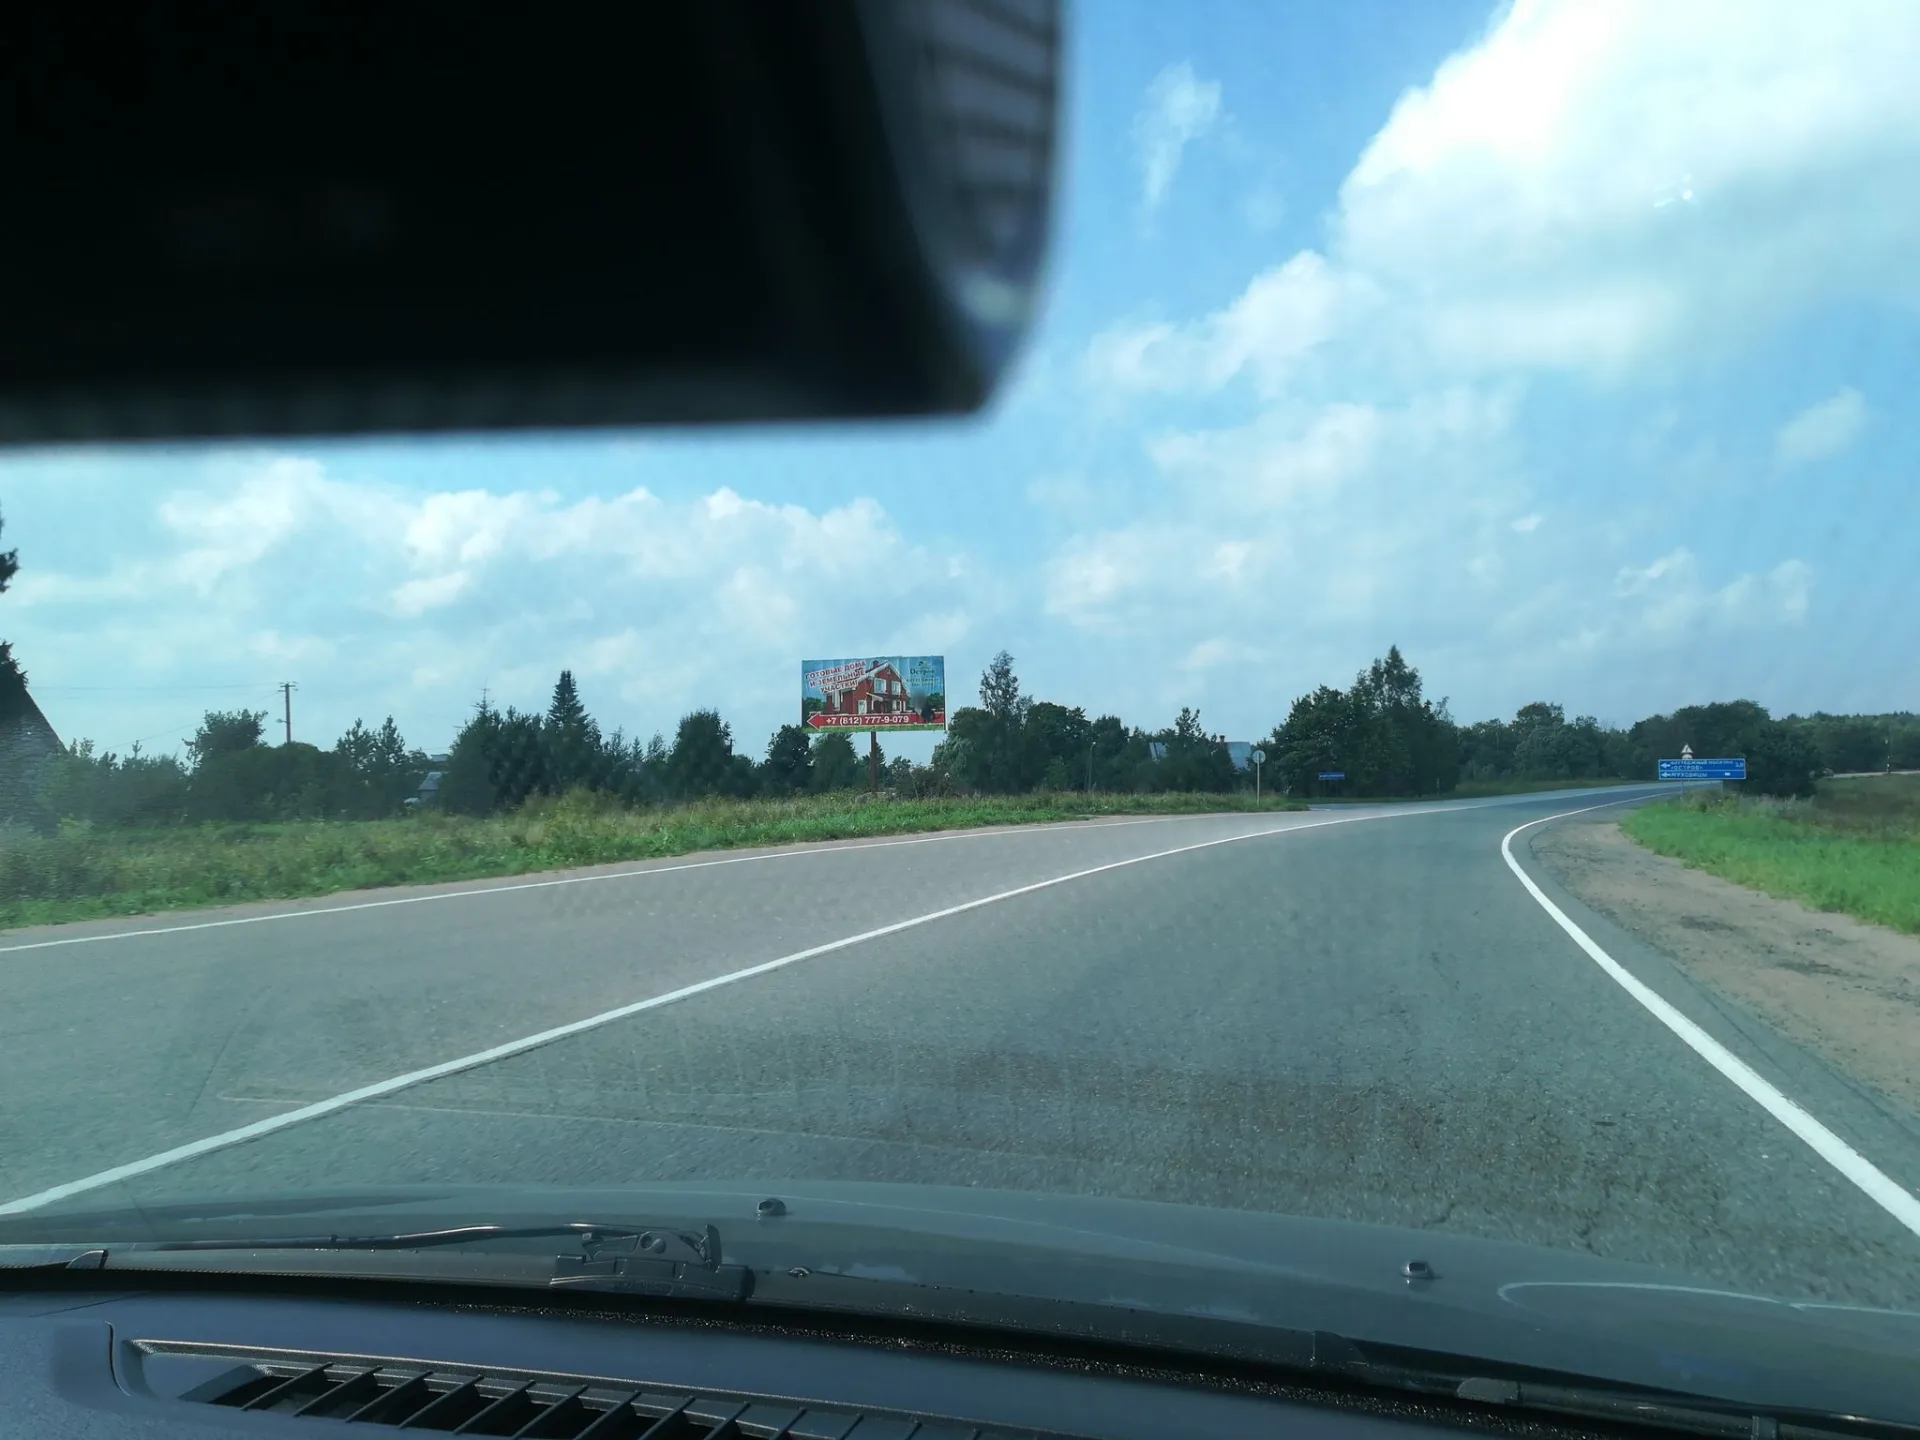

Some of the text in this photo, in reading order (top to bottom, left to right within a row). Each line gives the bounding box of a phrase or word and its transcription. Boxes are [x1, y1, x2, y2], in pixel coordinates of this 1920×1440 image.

[805, 661, 867, 679] ГОТОВЫЕ ДОМА
[819, 670, 865, 685] ЗЕМЕЛЬНЫЕ
[820, 680, 859, 693] УЧАСТКИ!
[826, 715, 909, 725] +7 (812) 777-9-079
